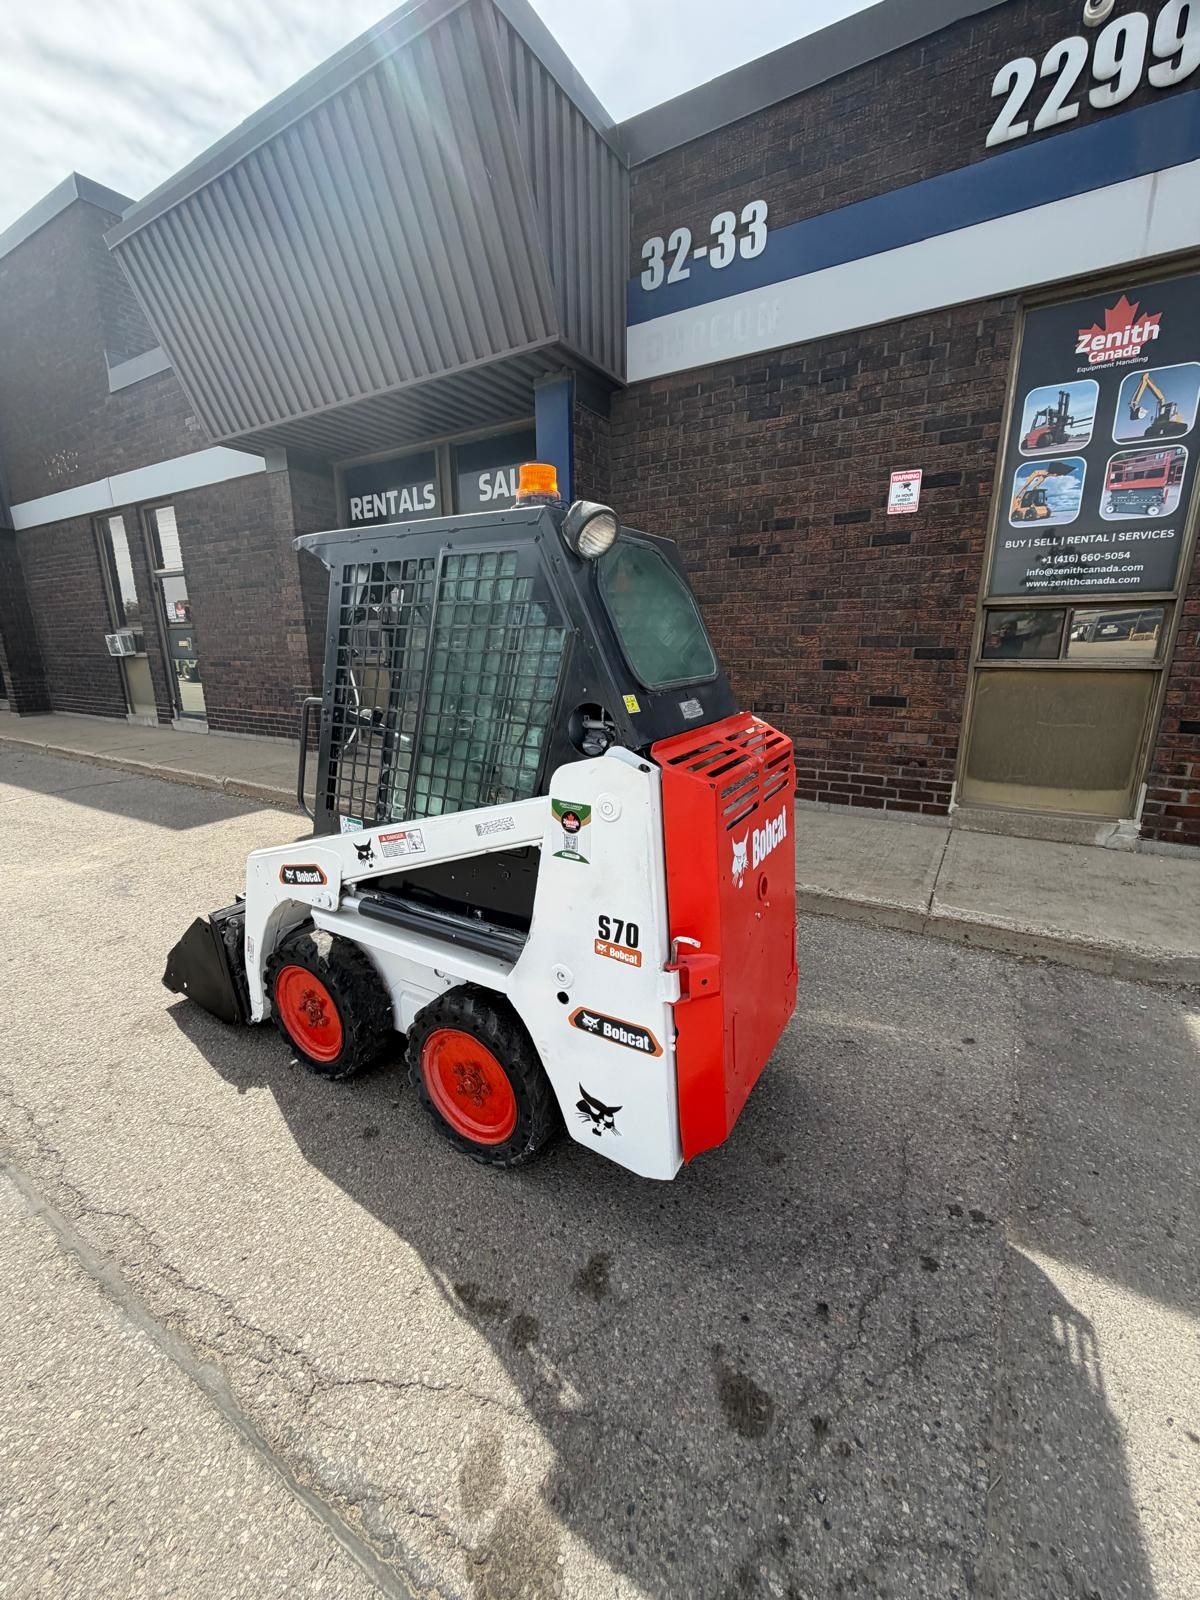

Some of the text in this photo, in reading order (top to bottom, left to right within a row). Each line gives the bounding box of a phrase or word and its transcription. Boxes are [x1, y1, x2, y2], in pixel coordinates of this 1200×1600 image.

[640, 199, 768, 291] 32-33
[1074, 321, 1160, 353] Zenith
[1088, 344, 1141, 363] Canada
[1077, 356, 1149, 373] Equipment Handling
[892, 473, 920, 482] WARNING
[350, 483, 436, 521] RENTALS
[1005, 539, 1027, 549] BUY
[1033, 537, 1059, 547] SELL
[1066, 534, 1110, 546] RENTAL
[1118, 529, 1175, 542] SERVICES
[1041, 551, 1131, 565] +1 (416) 660-5054
[1026, 564, 1144, 577] info@zenithcanada.com
[1026, 577, 1140, 588] www.zenithcanada.com
[753, 804, 787, 871] Bobcat
[296, 870, 321, 883] Bobcat
[598, 914, 639, 949] S70
[609, 947, 638, 965] Bobcat
[603, 1022, 650, 1051] Bobcat
